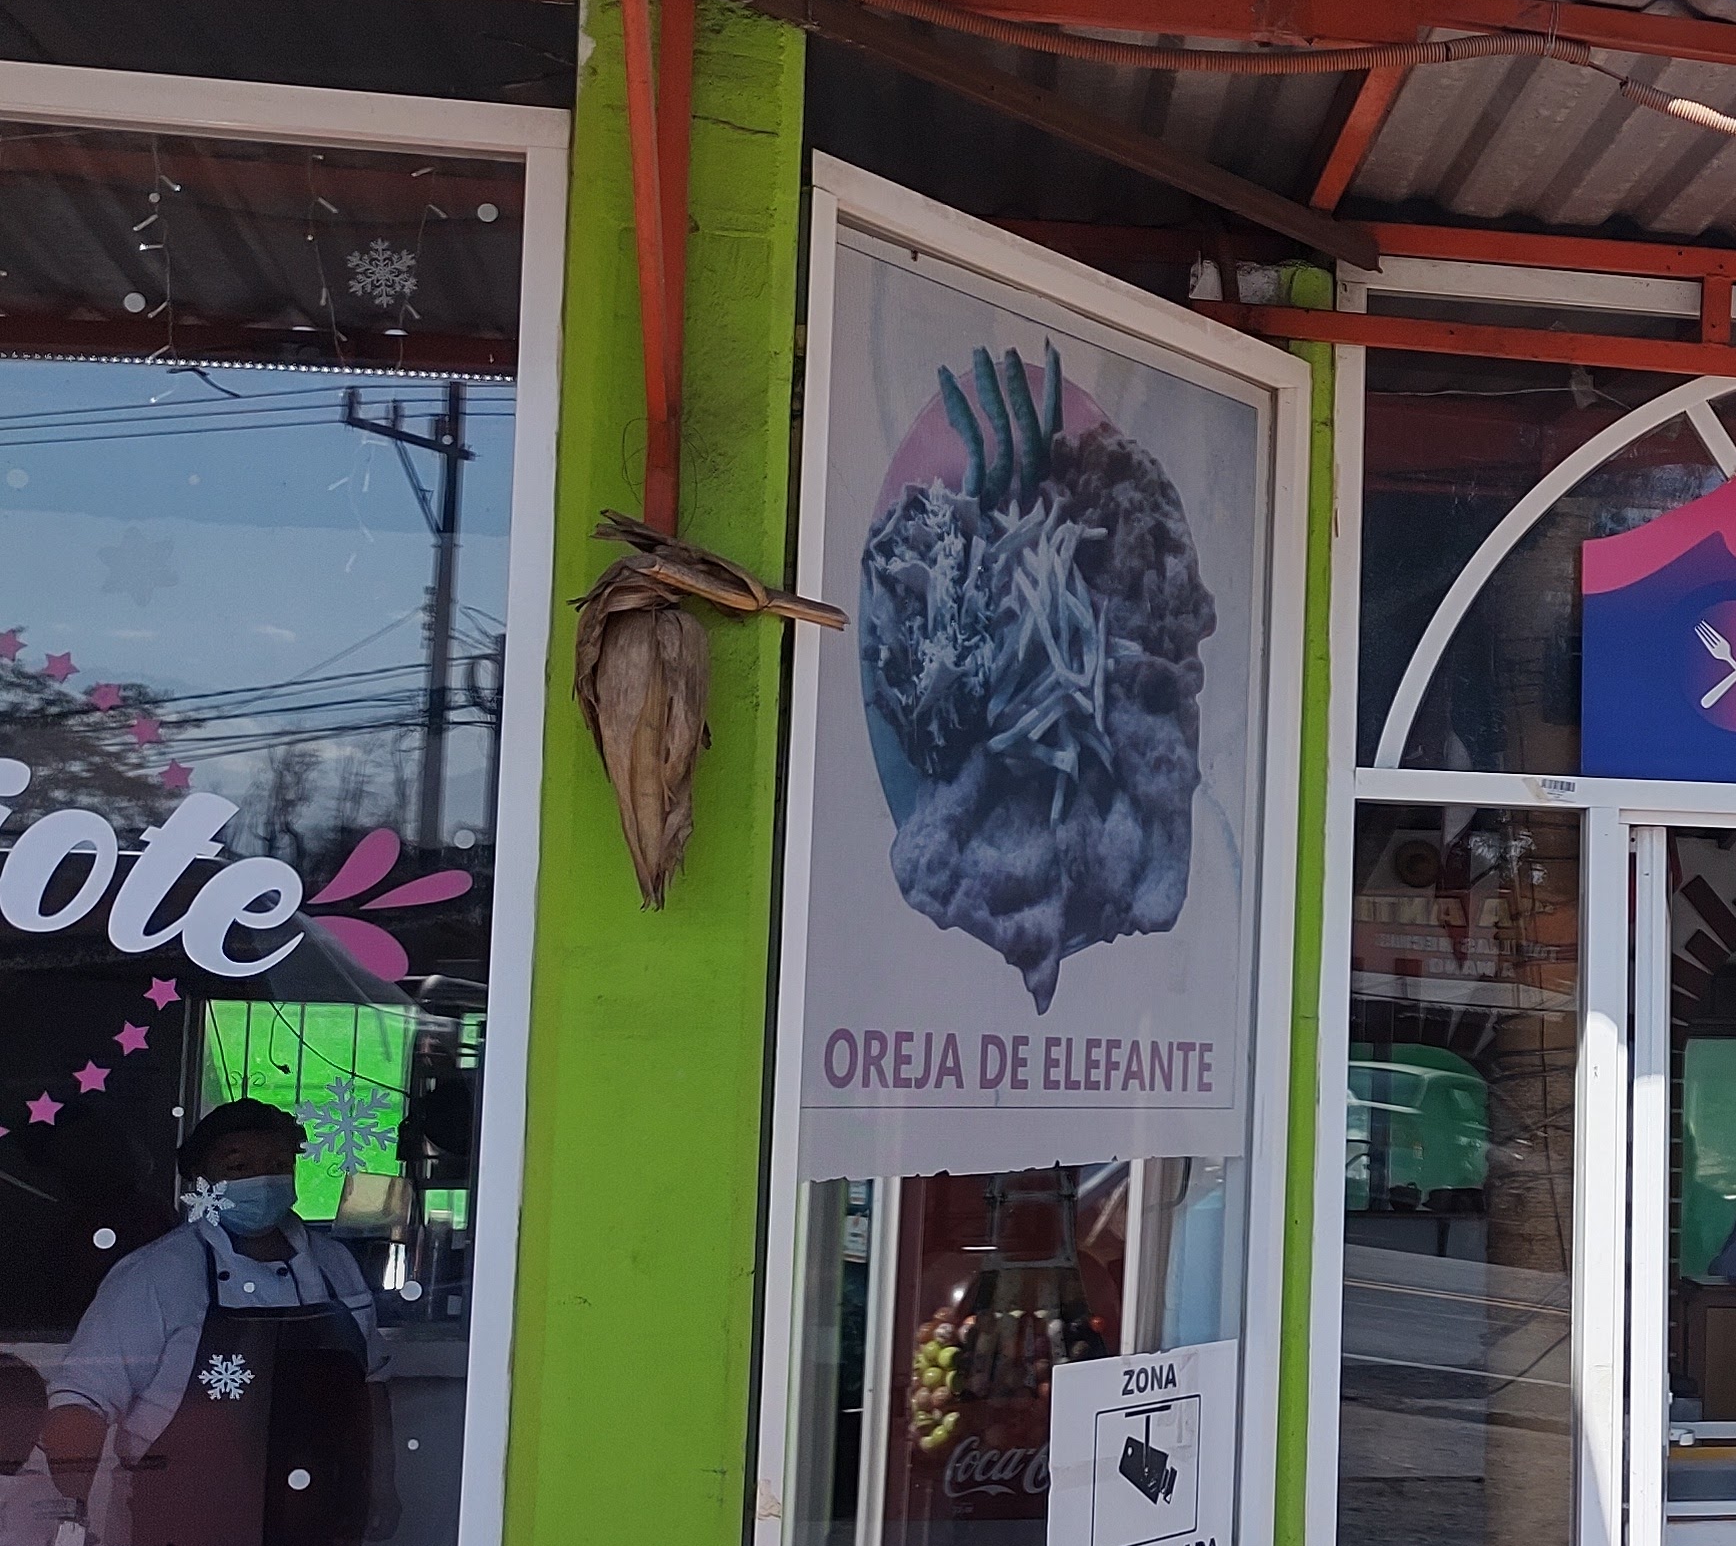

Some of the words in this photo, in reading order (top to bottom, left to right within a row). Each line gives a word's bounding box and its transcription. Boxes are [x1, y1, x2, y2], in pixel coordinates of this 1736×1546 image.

[0, 758, 305, 977] ote
[822, 1026, 966, 1090] OREJA
[978, 1033, 1031, 1092] DE
[1042, 1035, 1215, 1093] ELEFANTE
[1121, 1363, 1178, 1397] ZONA
